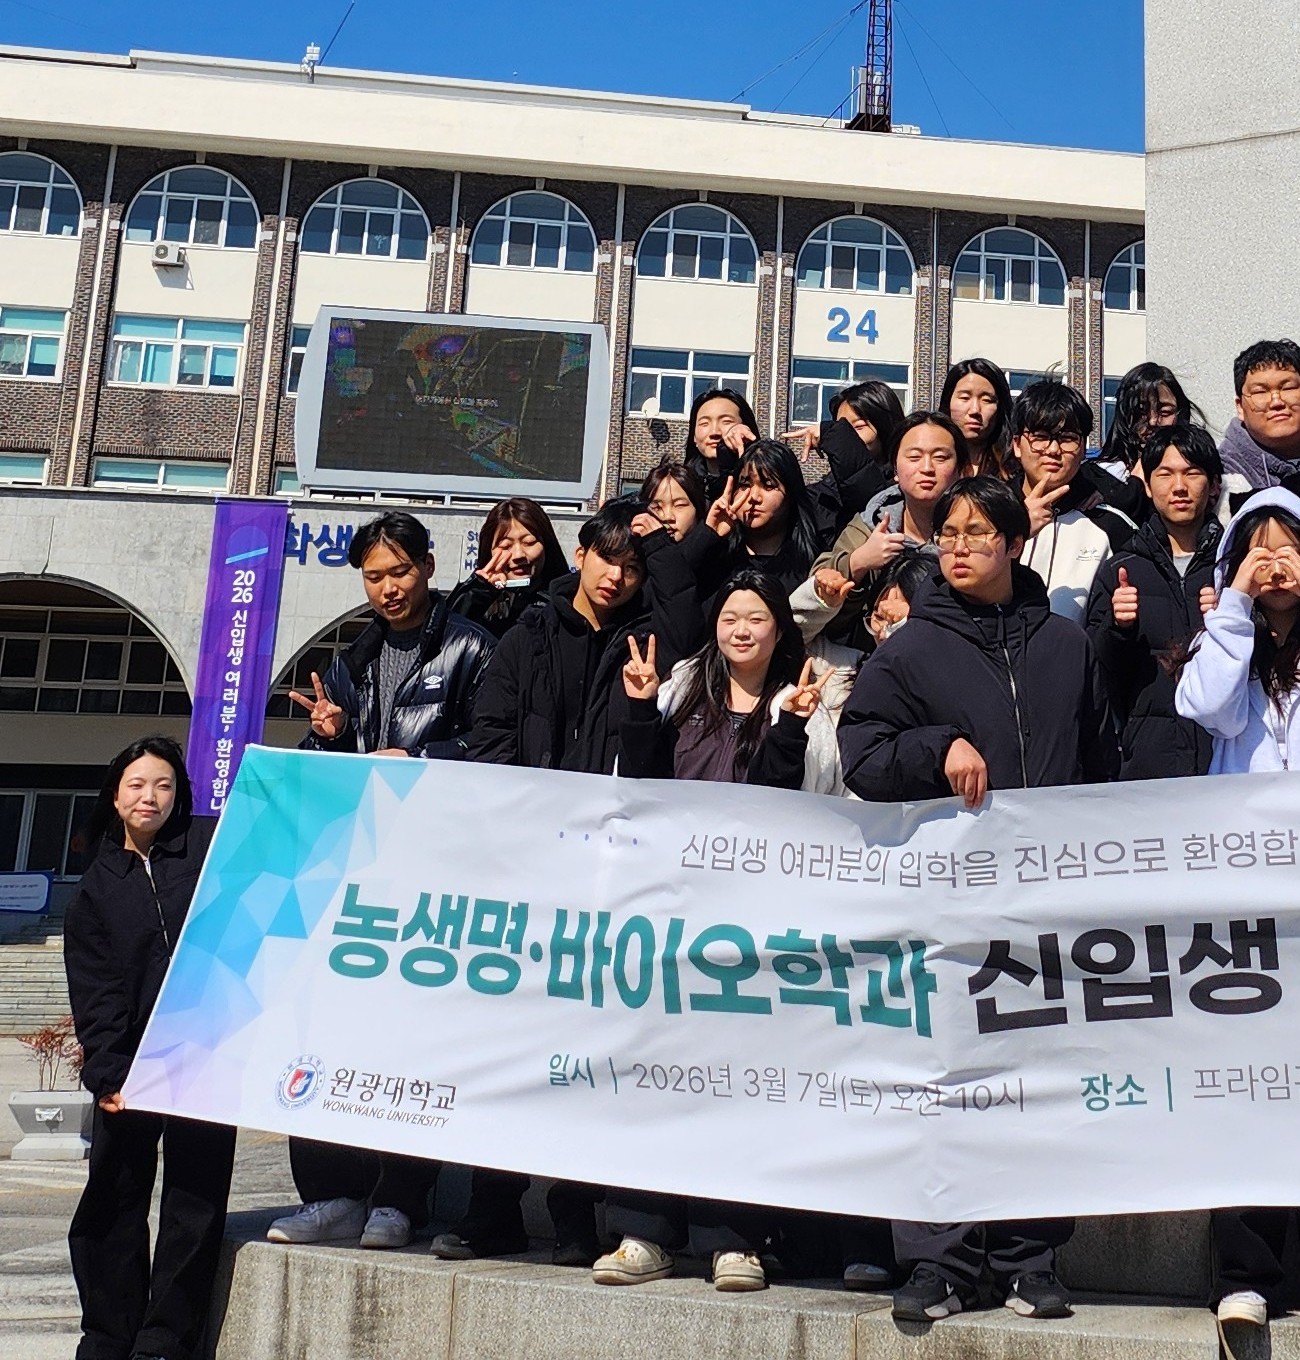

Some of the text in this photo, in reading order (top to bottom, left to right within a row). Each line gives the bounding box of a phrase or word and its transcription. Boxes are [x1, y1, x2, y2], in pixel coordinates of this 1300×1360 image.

[827, 307, 879, 344] 24
[227, 610, 248, 665] 신입생
[220, 671, 240, 732] 여러분,
[681, 834, 768, 874] 신입생
[780, 842, 891, 886] 여러분의
[899, 850, 999, 888] 입학을
[1014, 836, 1169, 884] 진심으로
[328, 883, 940, 1038] 농생명·바이오학과
[968, 917, 1282, 1034] 신입생
[330, 1067, 457, 1111] 원광대학교
[549, 1053, 595, 1089] 일시
[632, 1063, 734, 1099] 2026년
[743, 1066, 787, 1104] 3월
[797, 1071, 883, 1117] 7일(토)
[954, 1077, 1025, 1113] 10시
[1080, 1073, 1148, 1112] 장소
[322, 1099, 450, 1128] WONKWANG UNIVERSITY
